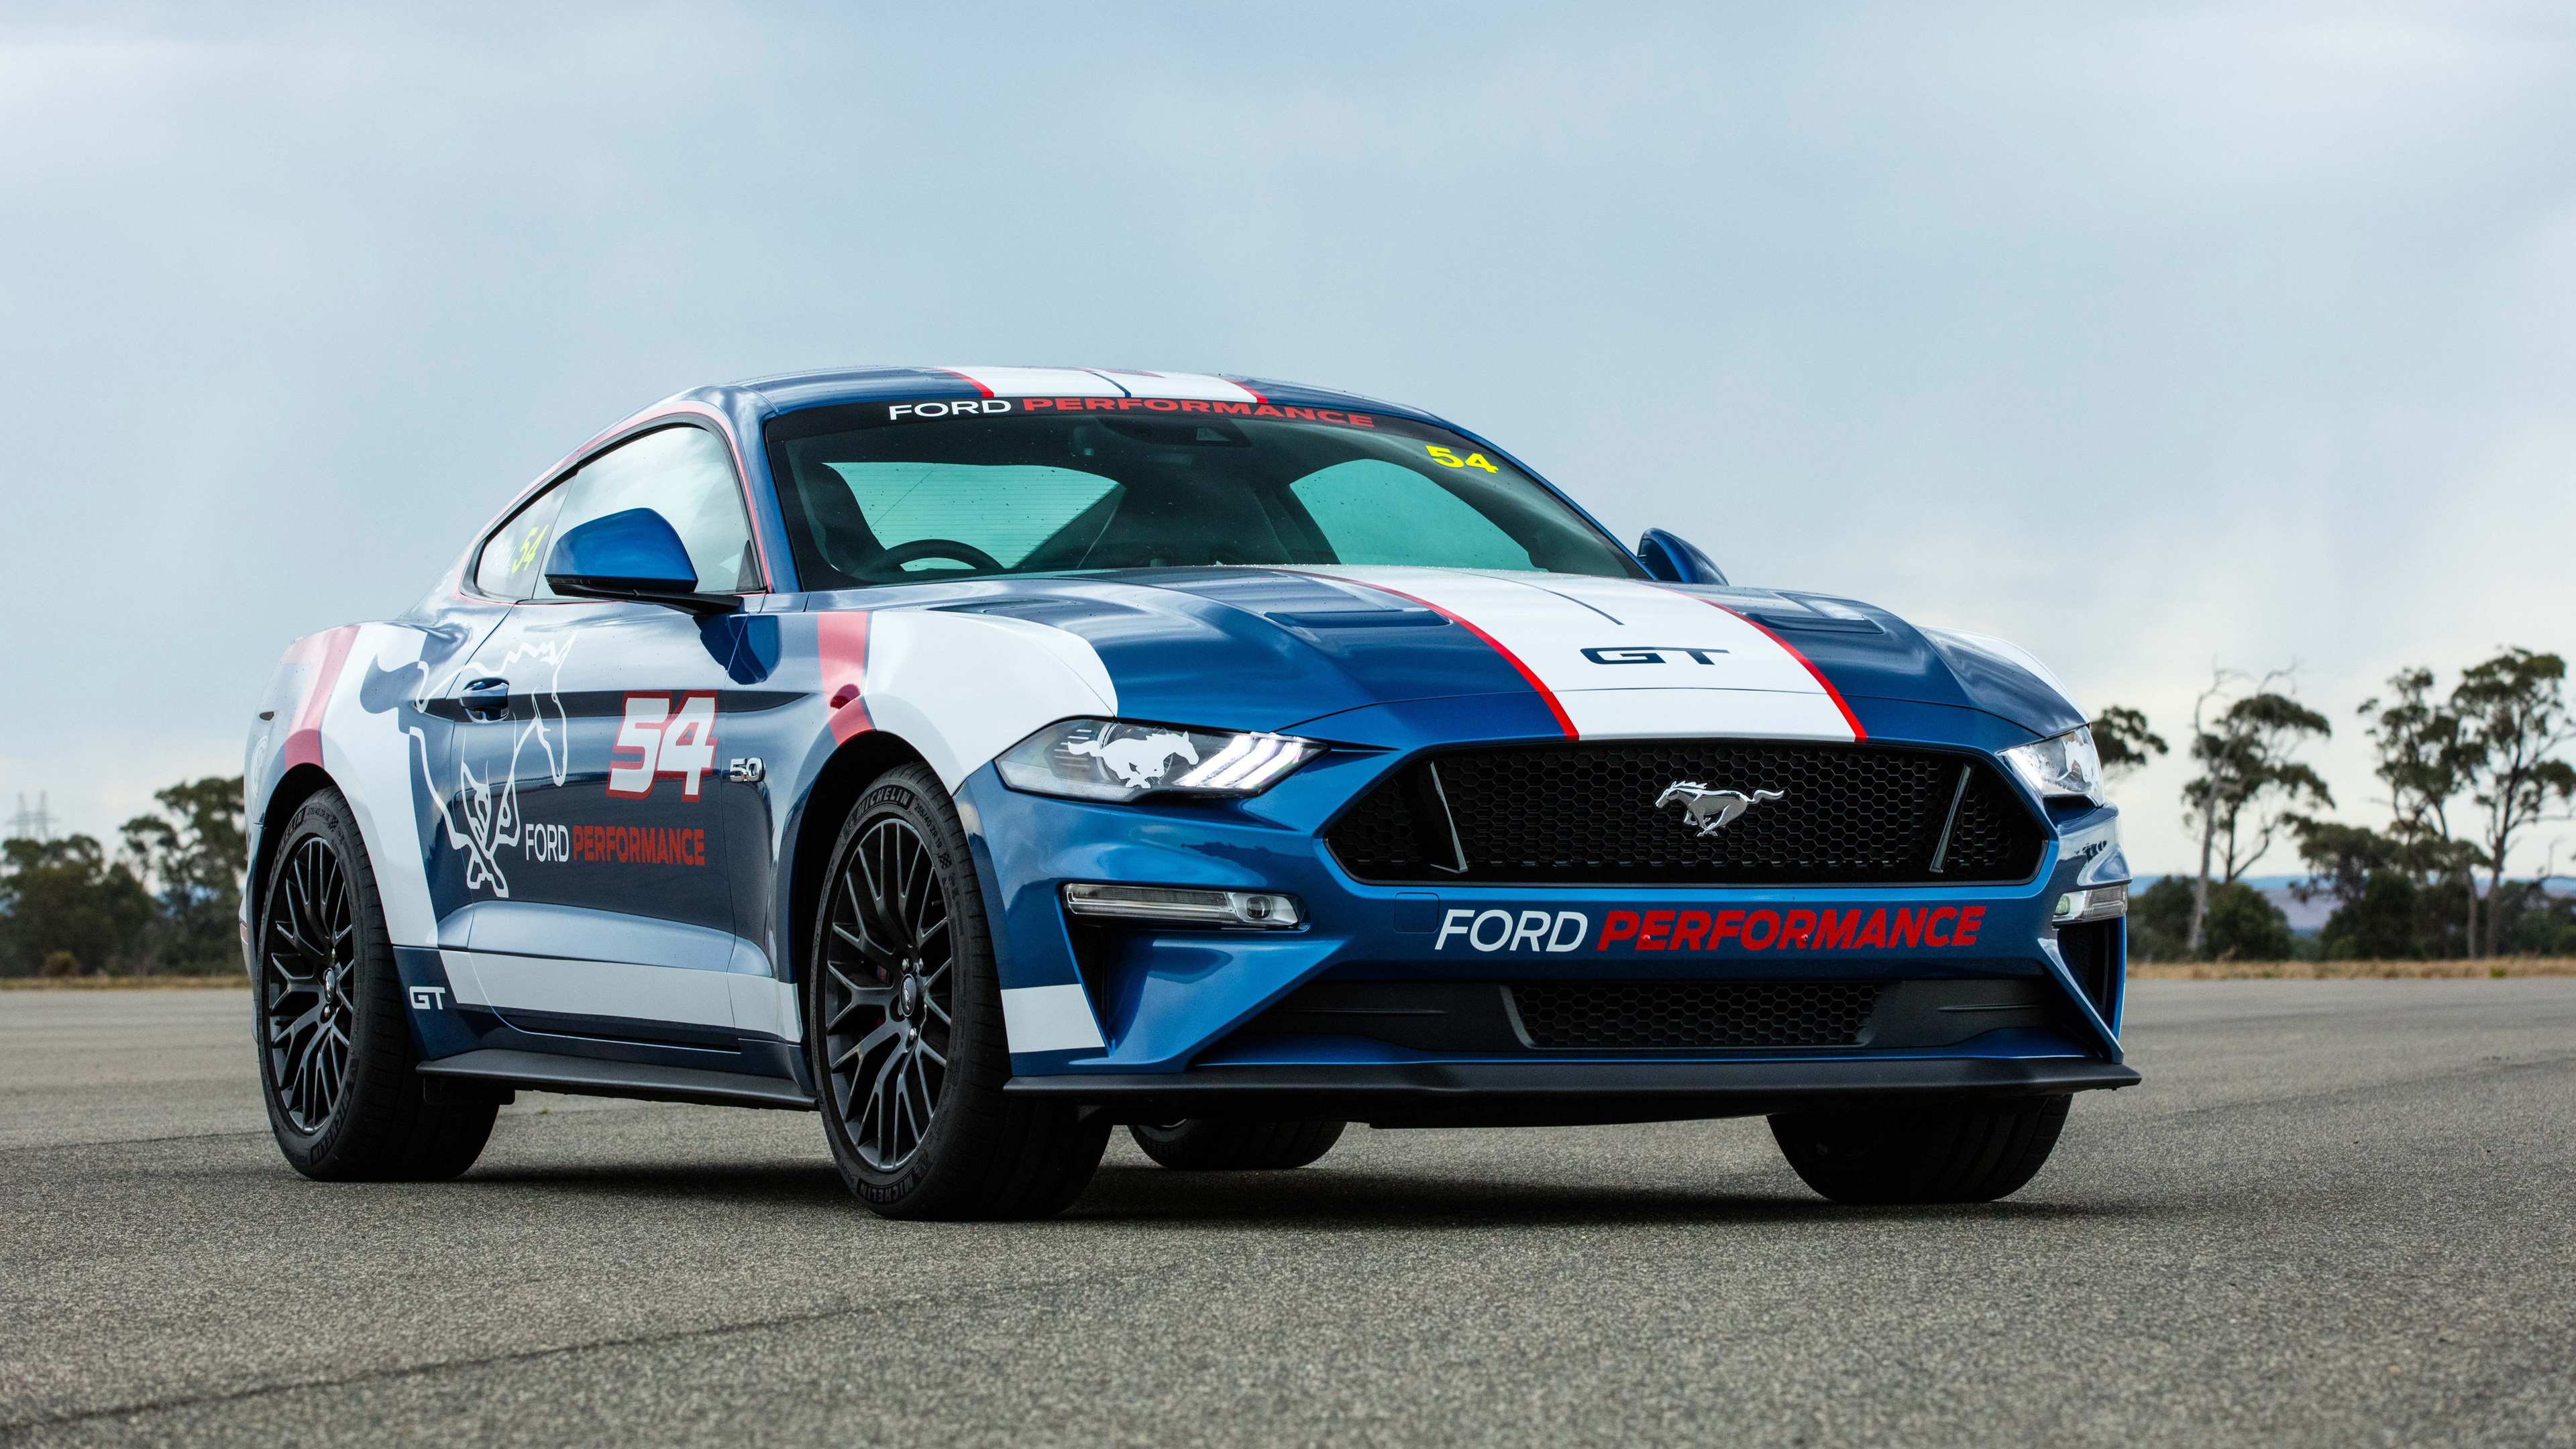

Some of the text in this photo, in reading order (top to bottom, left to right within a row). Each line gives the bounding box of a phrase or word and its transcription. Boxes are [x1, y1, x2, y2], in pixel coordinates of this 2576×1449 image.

[890, 397, 1375, 427] FORD PERFORMANCE
[1425, 445, 1499, 474] 54
[512, 524, 549, 574] 54
[1580, 646, 1730, 665] GT
[606, 690, 718, 802] 54
[857, 786, 911, 820] MICHELIN
[914, 803, 932, 828] 255/40
[526, 824, 705, 865] FORD PERFORMANCE
[1435, 906, 1986, 952] FORD PERFORMANCE
[410, 986, 445, 1010] GT
[841, 1162, 855, 1185] PILOT
[859, 1174, 914, 1203] MICHELIN
